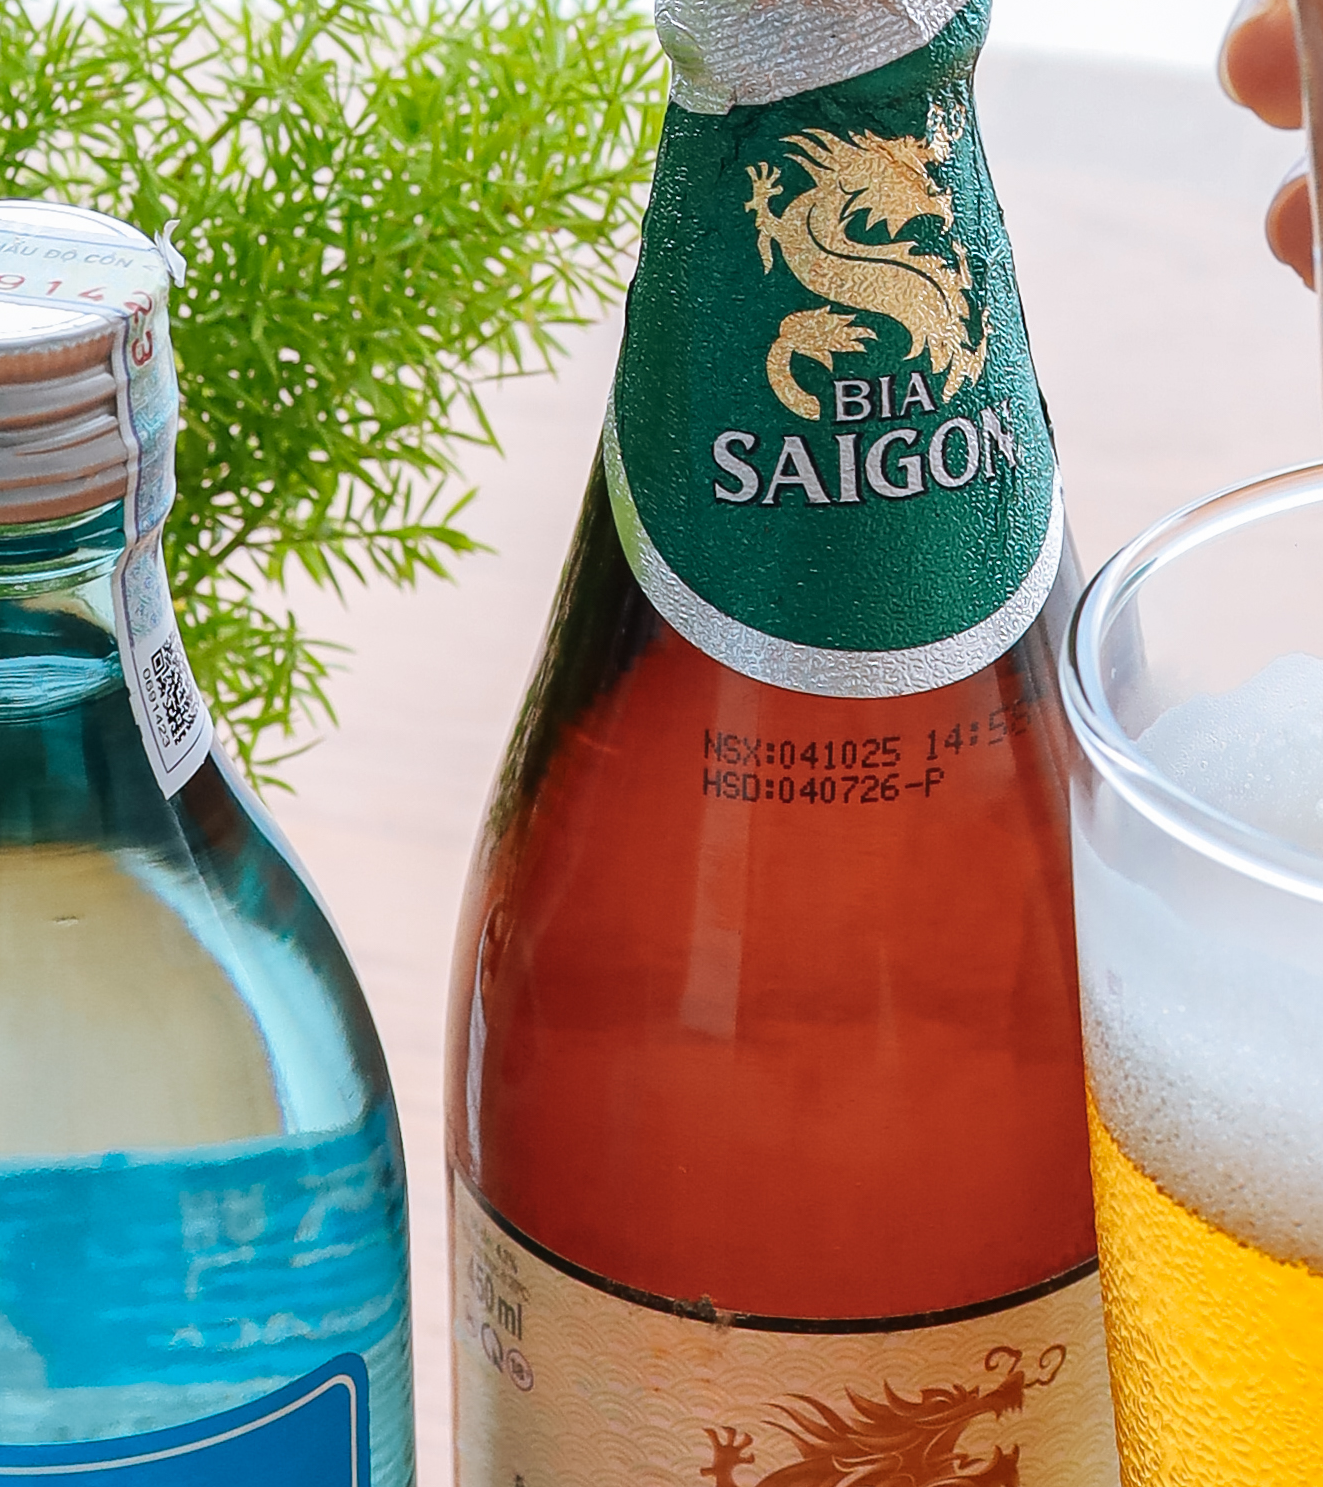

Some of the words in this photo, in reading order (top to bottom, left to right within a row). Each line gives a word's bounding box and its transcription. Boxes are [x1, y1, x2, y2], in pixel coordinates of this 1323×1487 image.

[832, 371, 939, 423] BIA
[711, 397, 1018, 507] SAIGON
[703, 728, 902, 771] NSX:041025
[702, 766, 945, 805] HSD:040726-P
